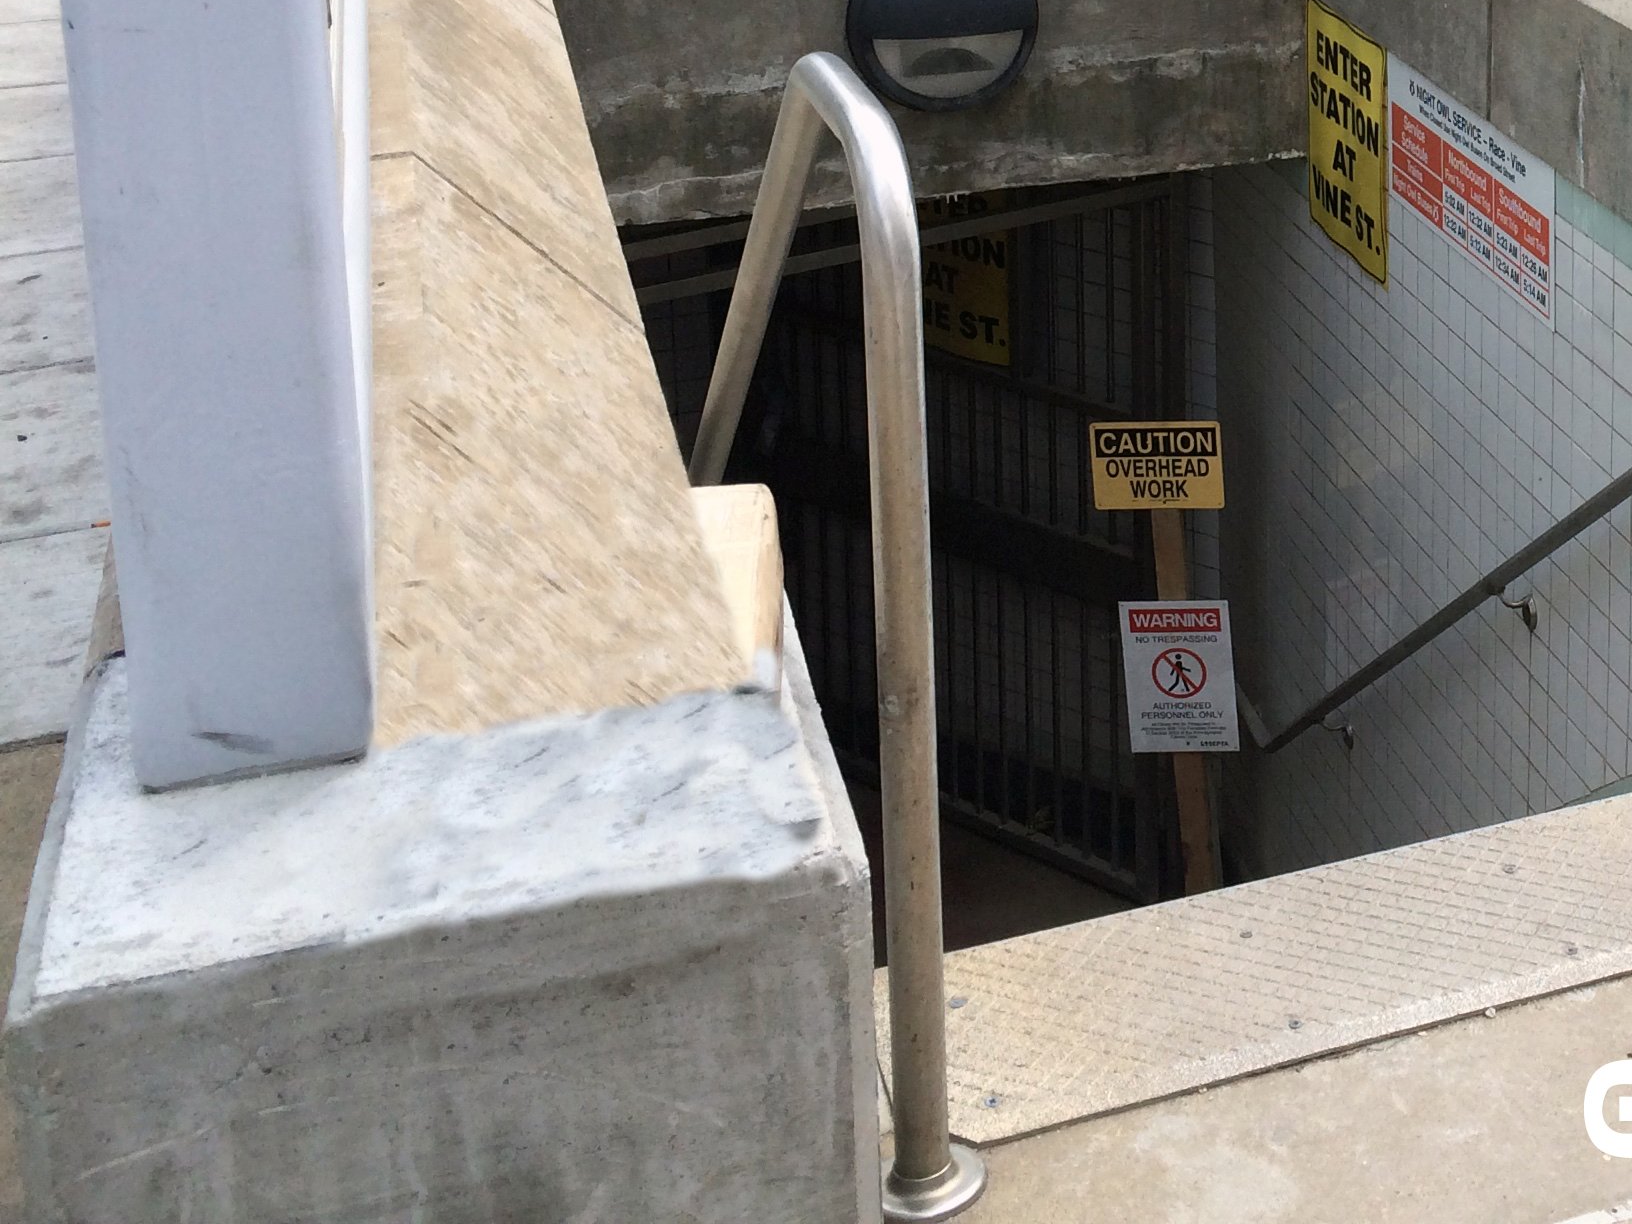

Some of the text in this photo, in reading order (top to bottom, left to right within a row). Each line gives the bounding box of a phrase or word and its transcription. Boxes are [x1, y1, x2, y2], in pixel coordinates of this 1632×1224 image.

[1316, 29, 1372, 102] ENTER
[1310, 71, 1379, 158] STATION
[1403, 114, 1426, 144] Service
[1416, 84, 1436, 110] NIGHT
[1437, 99, 1452, 123] OWL
[1453, 110, 1482, 145] SERVICE
[1489, 136, 1506, 162] Race
[1511, 152, 1527, 177] Vine
[1332, 139, 1357, 182] AT
[1448, 149, 1487, 192] Northbound
[1312, 163, 1381, 256] VINE ST.
[1499, 187, 1542, 234] Southbound
[1483, 221, 1492, 238] AM
[1482, 245, 1491, 261] AM
[1508, 242, 1518, 259] AM
[924, 261, 959, 294] AT
[1510, 267, 1520, 285] AM
[1538, 266, 1548, 283] AM
[1536, 289, 1546, 307] AM
[1099, 431, 1213, 454] CAUTION
[1105, 458, 1210, 478] OVERHEAD
[1129, 479, 1189, 498] WORK
[1132, 612, 1218, 628] WARNING
[1135, 635, 1218, 644] NO TRESPASSING
[1140, 711, 1224, 719] PERSONNEL ONLY
[1152, 701, 1212, 710] AUTHORIZED
